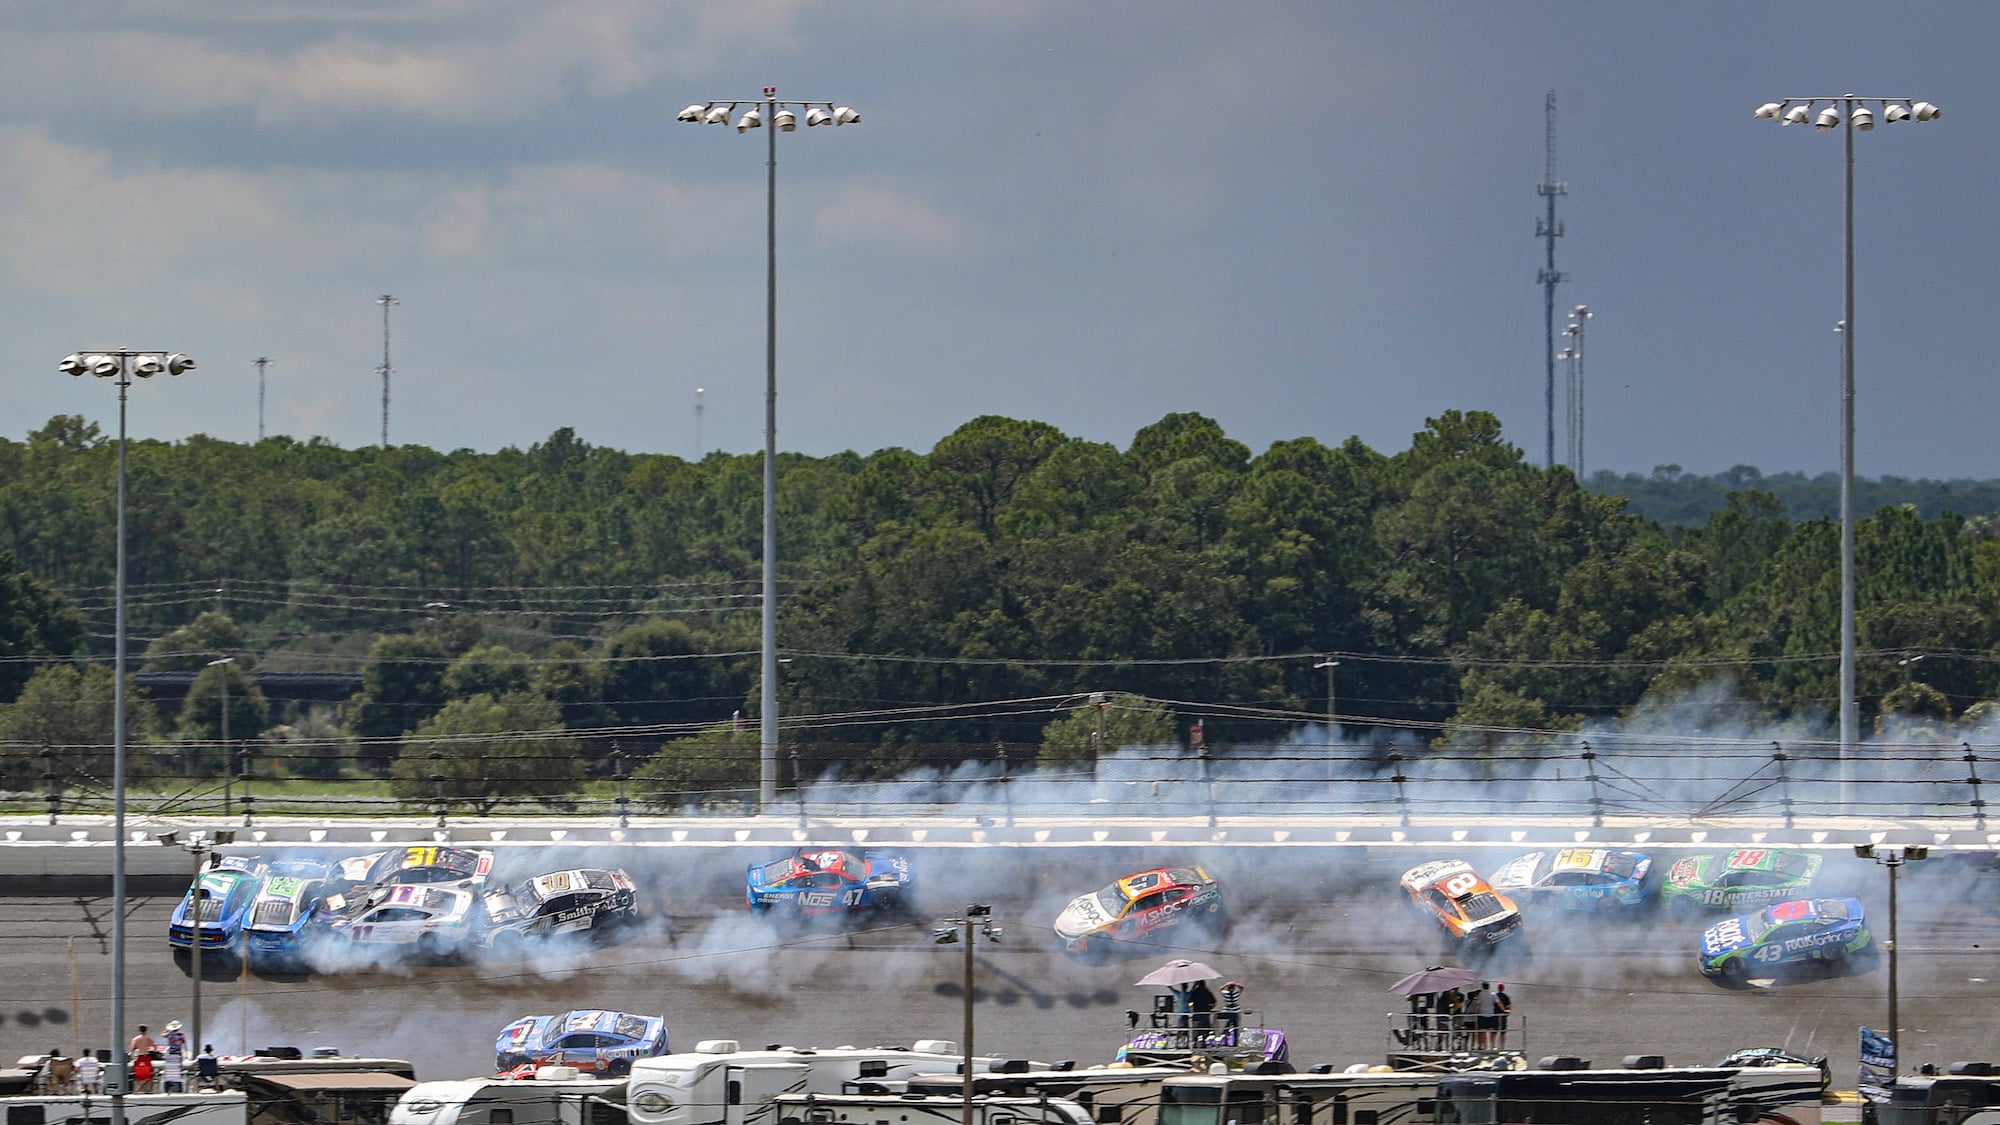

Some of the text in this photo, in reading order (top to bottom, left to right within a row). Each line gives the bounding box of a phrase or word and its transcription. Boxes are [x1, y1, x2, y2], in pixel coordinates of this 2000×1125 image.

[405, 847, 438, 866] 31
[1559, 849, 1594, 868] 16
[1729, 849, 1767, 868] 18
[541, 872, 570, 891] 10
[1446, 873, 1478, 896] 8
[384, 886, 417, 903] 11
[798, 892, 837, 907] NOS
[842, 889, 864, 907] 47
[1188, 893, 1211, 906] ASHOC
[1574, 888, 1605, 898] Cirkul
[1703, 889, 1725, 905] 18
[1728, 888, 1797, 901] INTERSTATE
[1076, 898, 1105, 925] ASHOC
[1141, 902, 1182, 926] ASHOC
[1771, 900, 1810, 921] 43
[352, 925, 374, 941] 11
[1754, 945, 1782, 963] 43
[570, 1012, 603, 1031] 4
[544, 1051, 566, 1067] 4
[595, 1048, 628, 1059] Mobil
